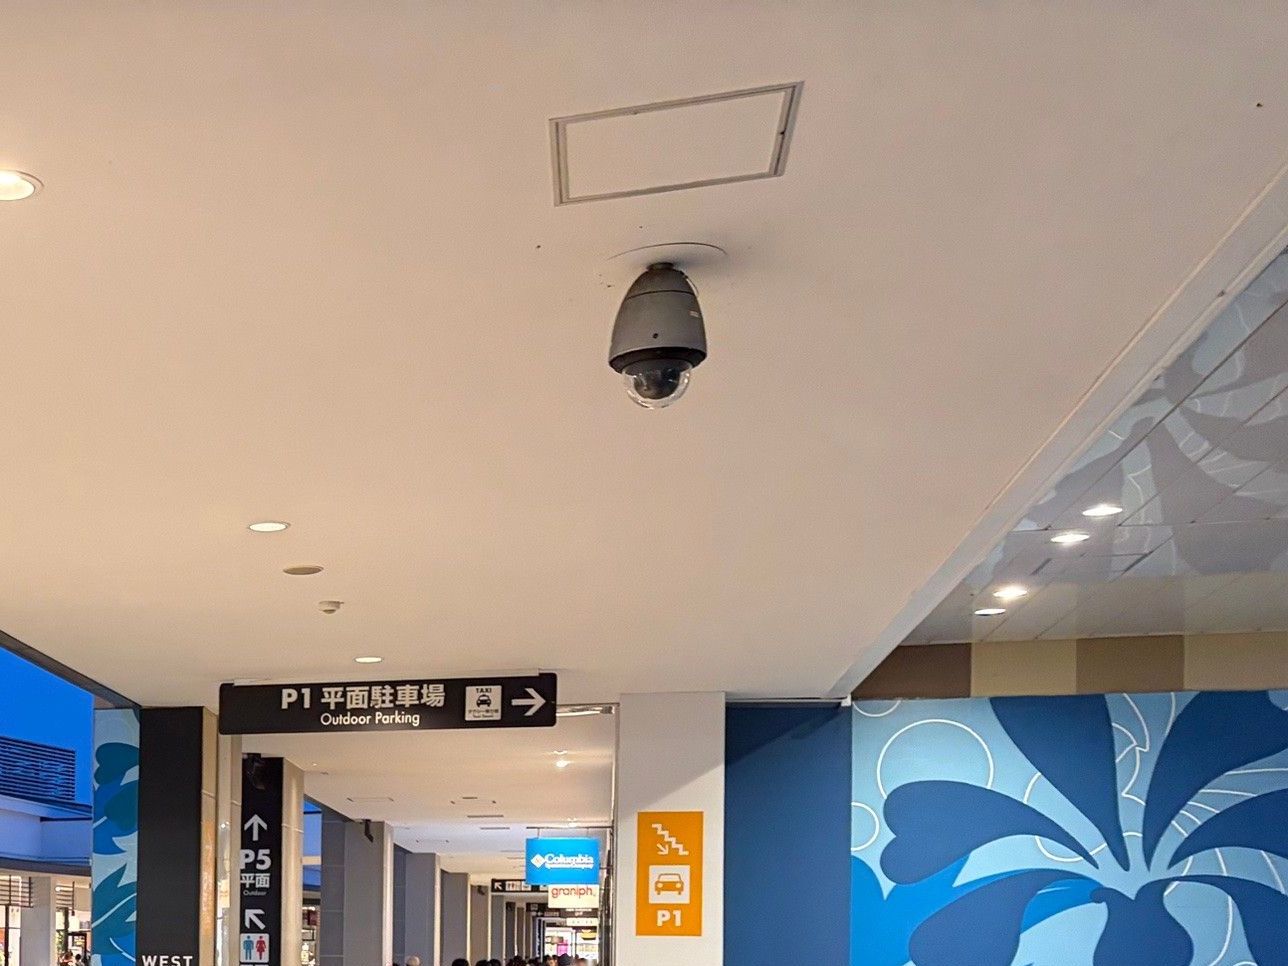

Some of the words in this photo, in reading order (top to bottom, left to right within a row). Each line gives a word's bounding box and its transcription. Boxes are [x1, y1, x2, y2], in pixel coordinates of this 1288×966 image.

[281, 688, 311, 710] P1
[320, 683, 445, 710] 平面駐車場
[320, 711, 372, 727] Outdoor
[374, 710, 420, 727] Parking
[240, 848, 272, 871] P5
[545, 853, 594, 864] Columbia
[240, 873, 271, 888] 平面
[551, 885, 593, 899] graniph
[656, 909, 682, 927] P1
